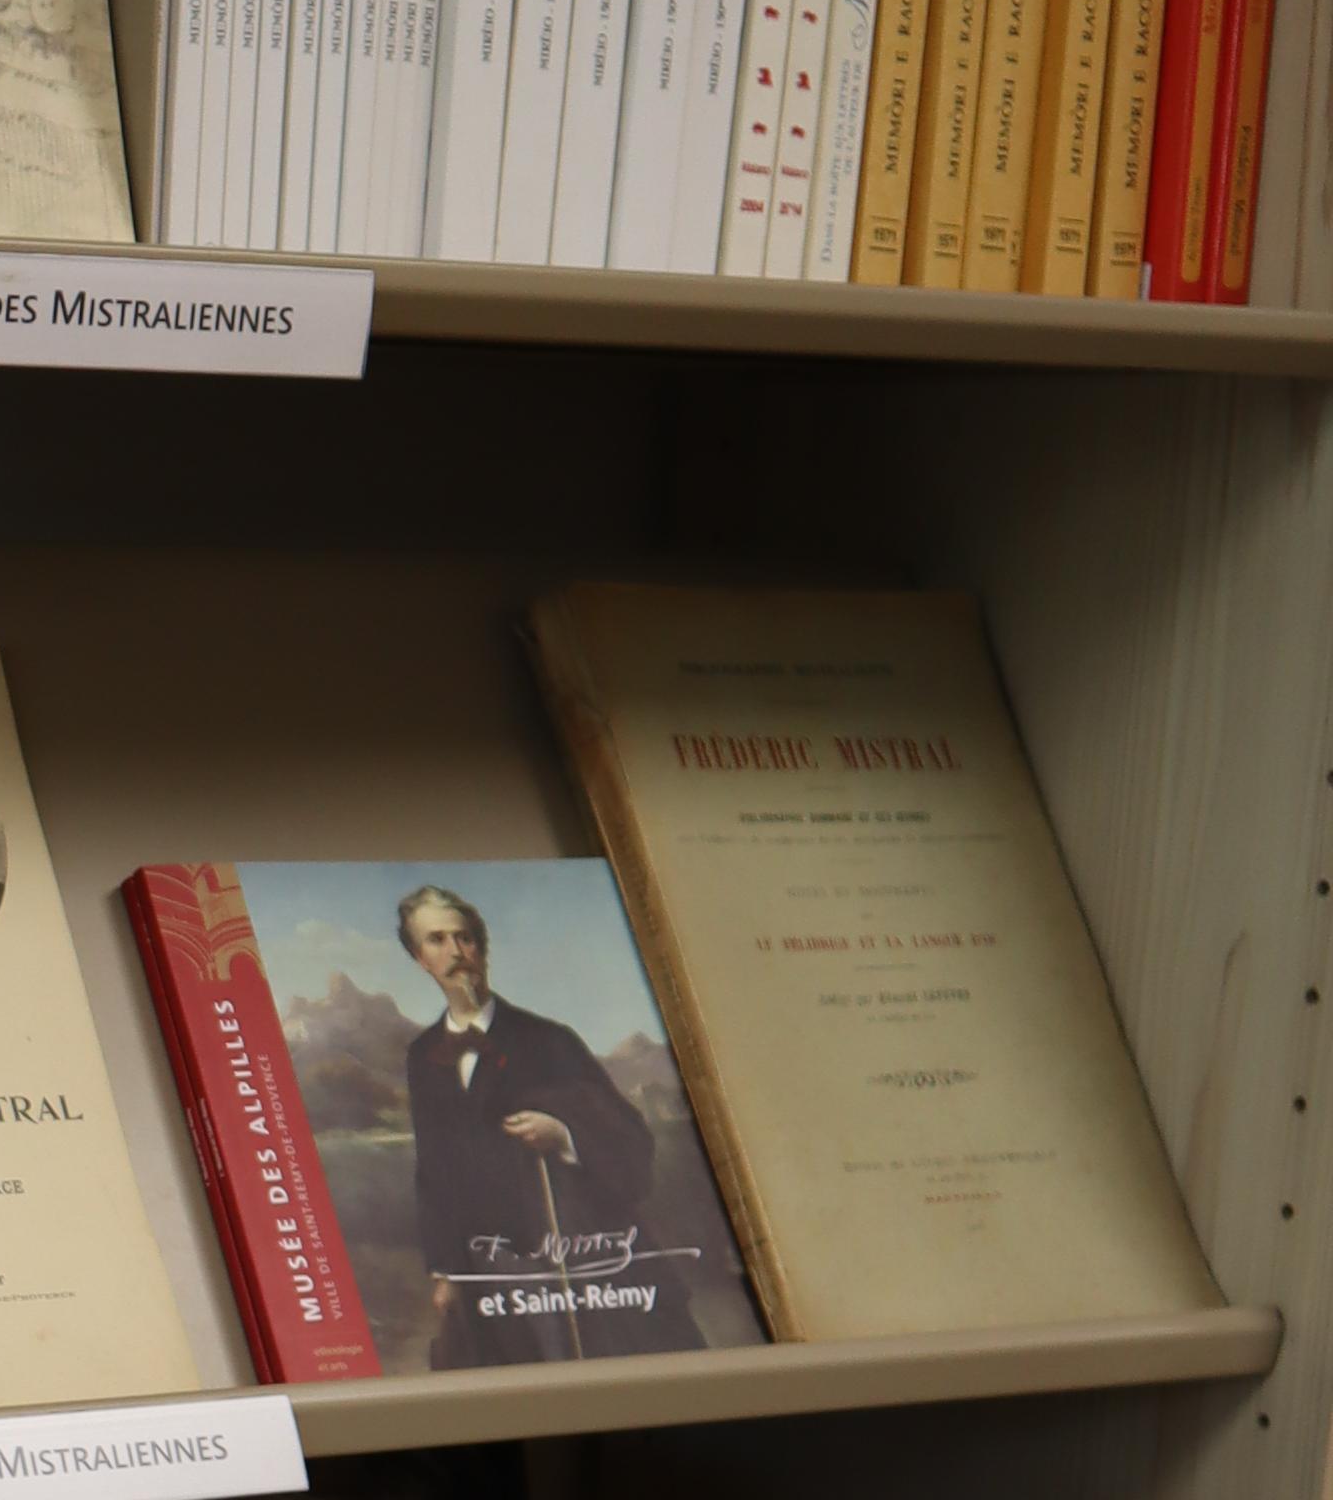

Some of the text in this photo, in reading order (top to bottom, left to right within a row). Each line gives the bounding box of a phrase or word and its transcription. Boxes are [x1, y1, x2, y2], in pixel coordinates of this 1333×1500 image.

[895, 50, 909, 64] E
[214, 999, 323, 1322] MUSÉE DES ALPILLES
[477, 1280, 658, 1317] et Saint-Rémy
